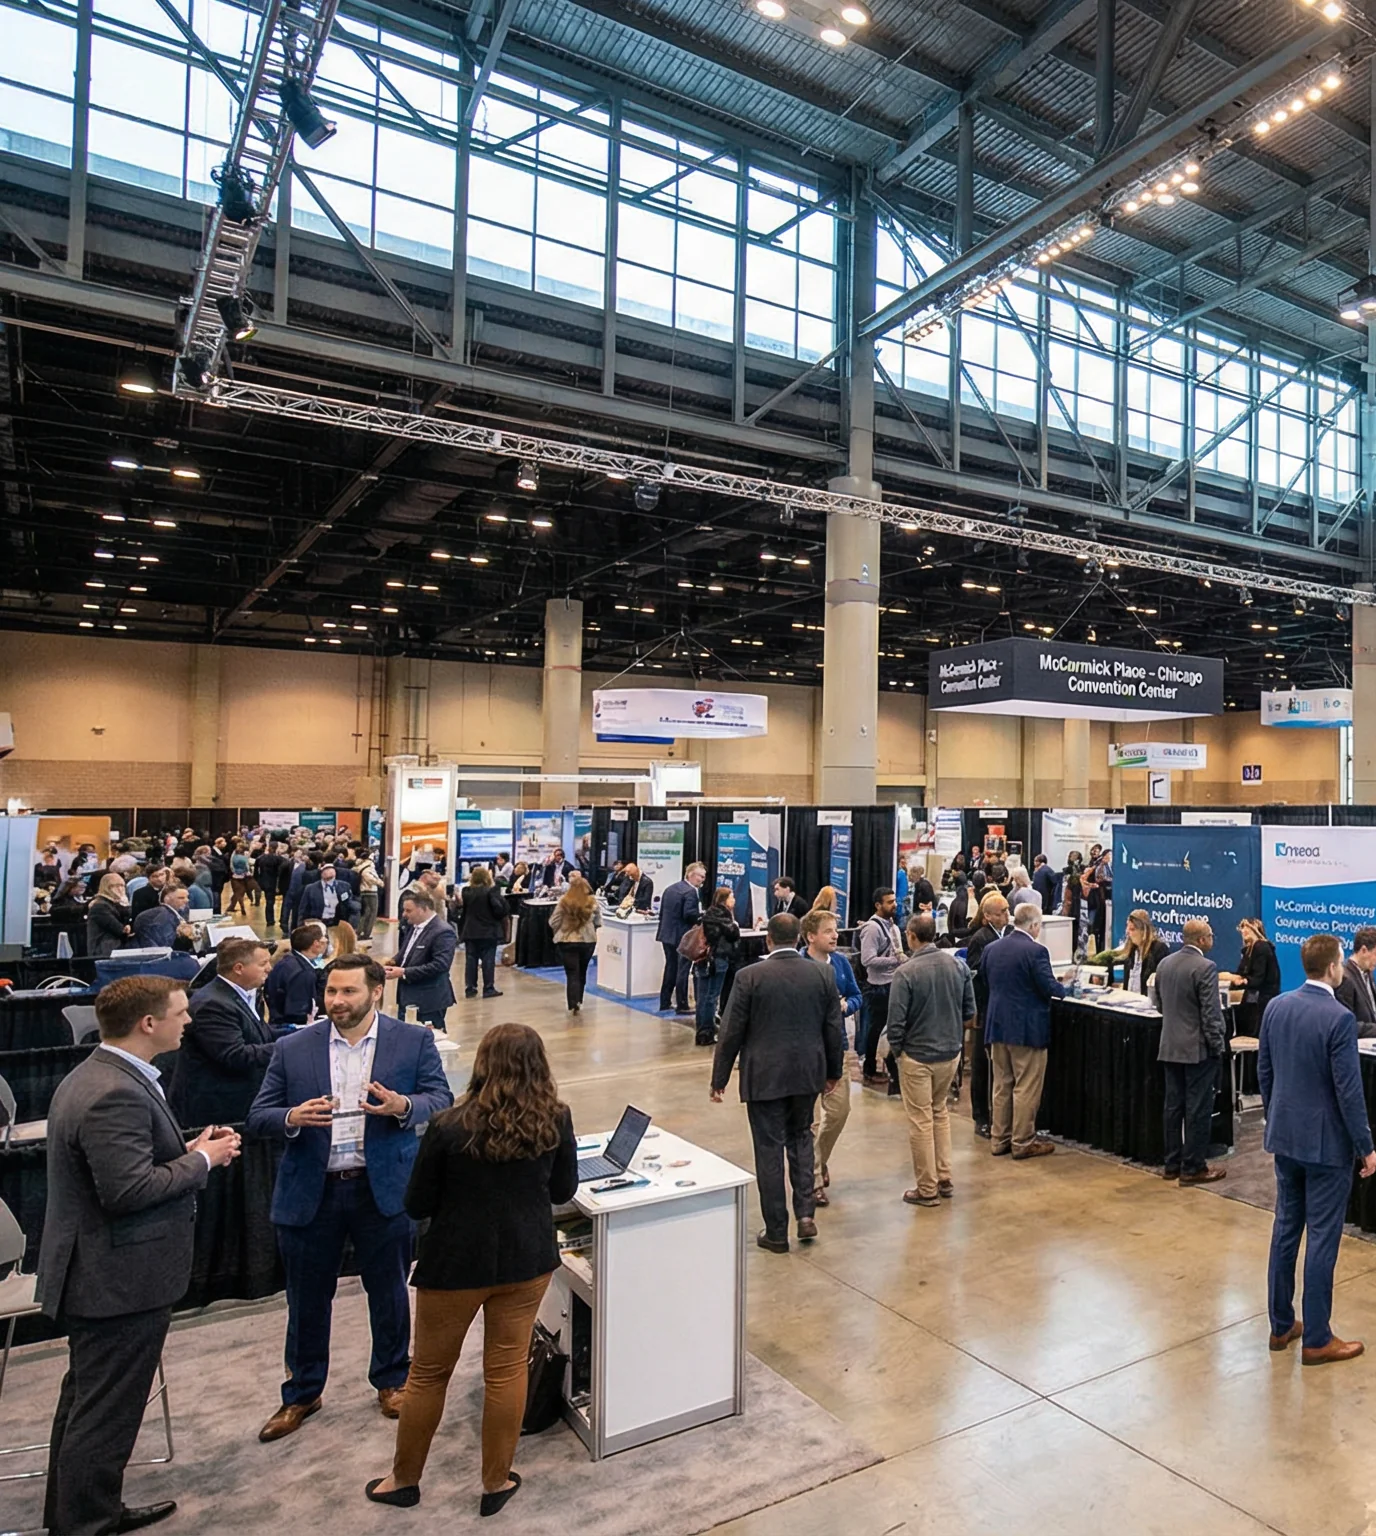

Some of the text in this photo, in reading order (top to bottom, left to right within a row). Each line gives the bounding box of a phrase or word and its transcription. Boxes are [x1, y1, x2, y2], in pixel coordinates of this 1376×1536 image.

[1068, 675, 1178, 699] Convention Center
[1157, 665, 1203, 687] Chicago
